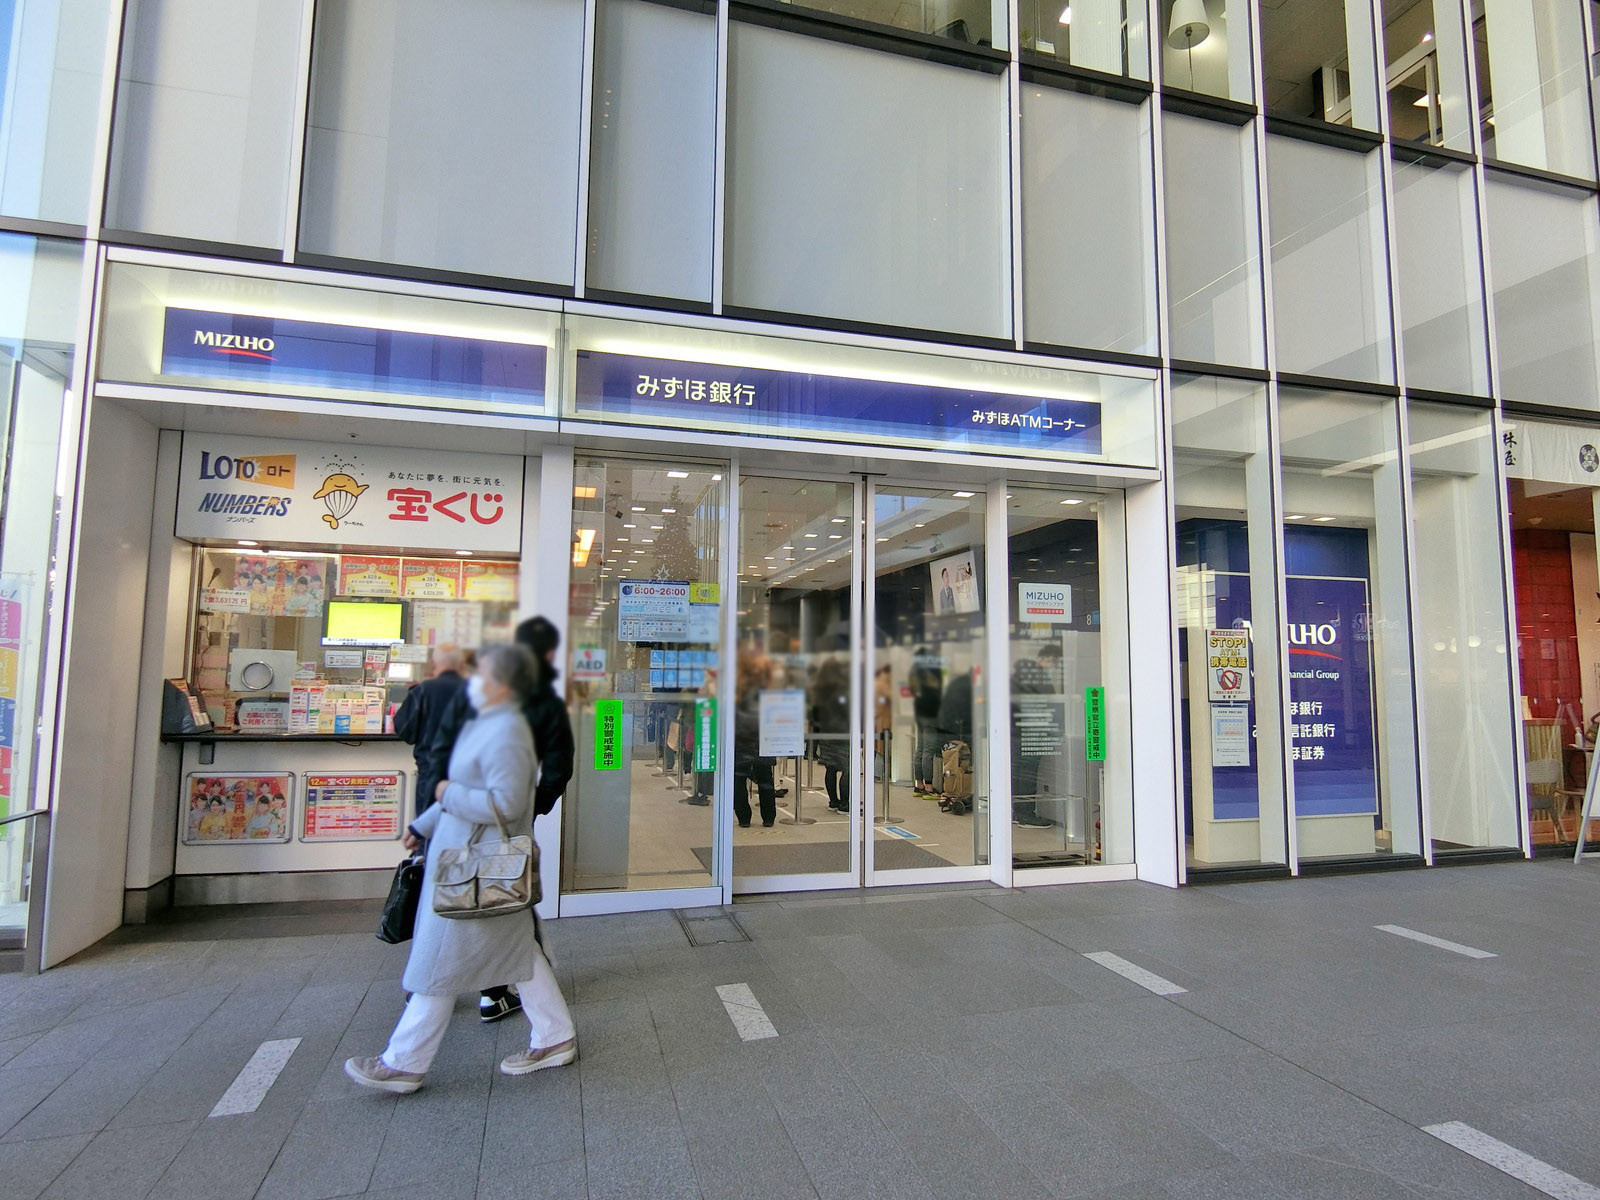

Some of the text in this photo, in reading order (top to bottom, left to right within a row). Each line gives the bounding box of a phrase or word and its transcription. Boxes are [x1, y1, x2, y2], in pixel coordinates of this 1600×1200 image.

[193, 330, 275, 352] MIZUHO
[636, 374, 755, 407] みずほ銀行
[972, 410, 1085, 430] みずほATMコーナー
[199, 451, 290, 480] LOTO ロト
[198, 492, 292, 517] NUMBERS
[387, 487, 504, 525] 宝くじ
[634, 587, 686, 596] 6:00~26:00
[1026, 592, 1064, 601] MIZUHO
[1210, 637, 1246, 648] STOP!
[576, 660, 604, 670] AED
[1210, 656, 1247, 668] 携帯電話
[1289, 669, 1340, 681] nancial Group
[1291, 701, 1323, 716] ほ銀行
[603, 715, 614, 767] 特別警戒実施中
[1293, 746, 1325, 761] ほ証券
